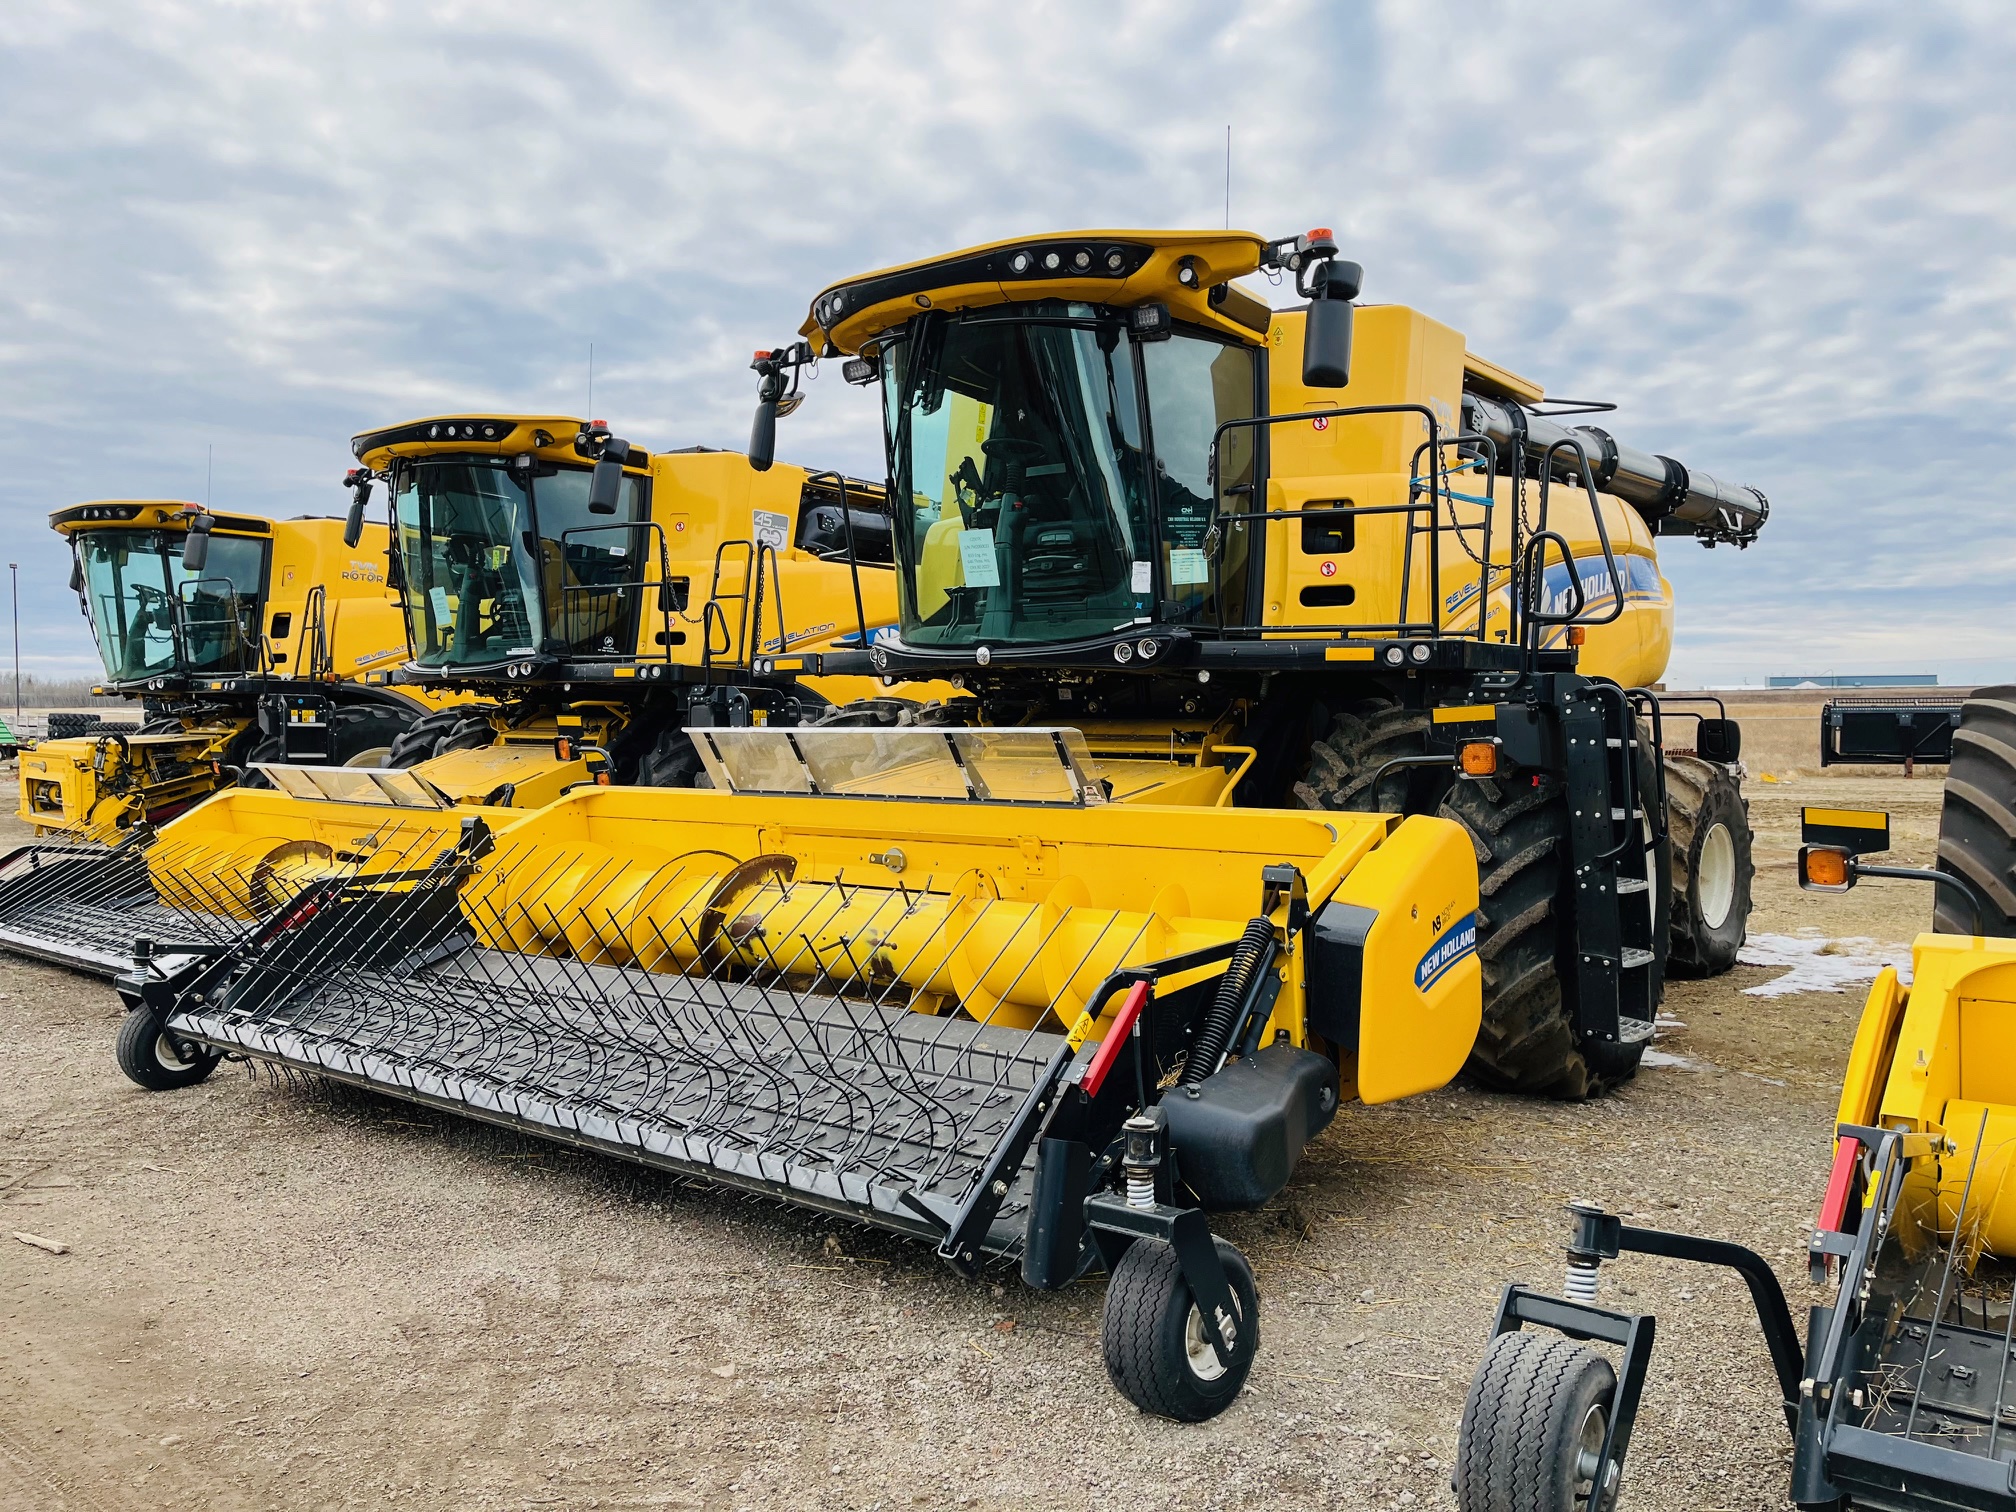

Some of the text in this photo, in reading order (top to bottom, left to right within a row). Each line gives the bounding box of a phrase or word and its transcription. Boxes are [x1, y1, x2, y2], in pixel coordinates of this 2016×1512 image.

[754, 512, 773, 527] 45
[349, 560, 378, 571] TWIN
[341, 570, 384, 583] ROTOR
[763, 623, 836, 648] REELATION
[1421, 927, 1476, 981] NEW HOLLAND
